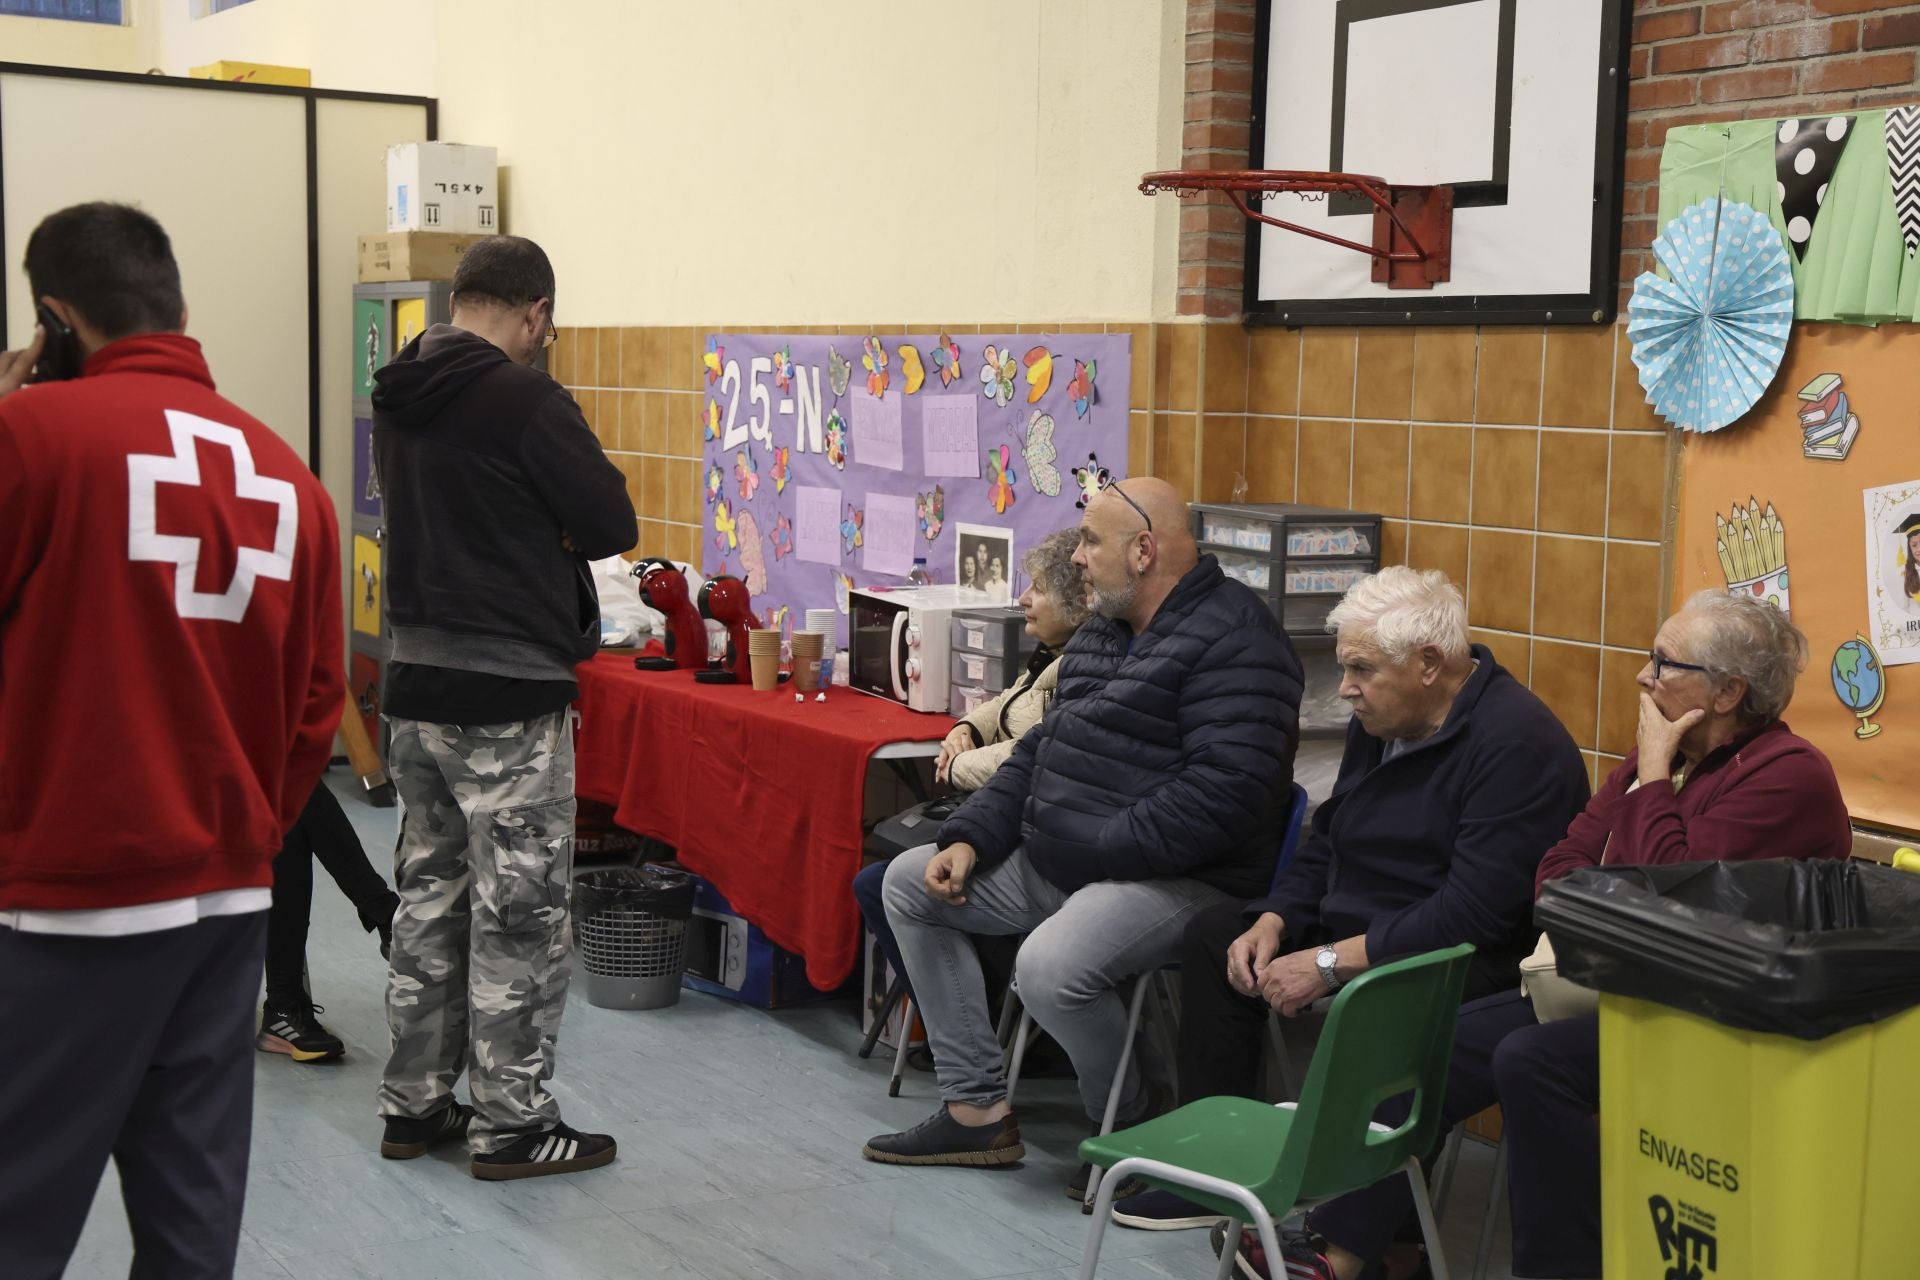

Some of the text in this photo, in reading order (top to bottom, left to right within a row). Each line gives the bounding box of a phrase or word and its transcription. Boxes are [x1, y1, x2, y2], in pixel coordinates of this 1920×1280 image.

[475, 184, 484, 195] 4
[721, 357, 822, 455] 25-N
[1640, 1128, 1739, 1193] ENVASES
